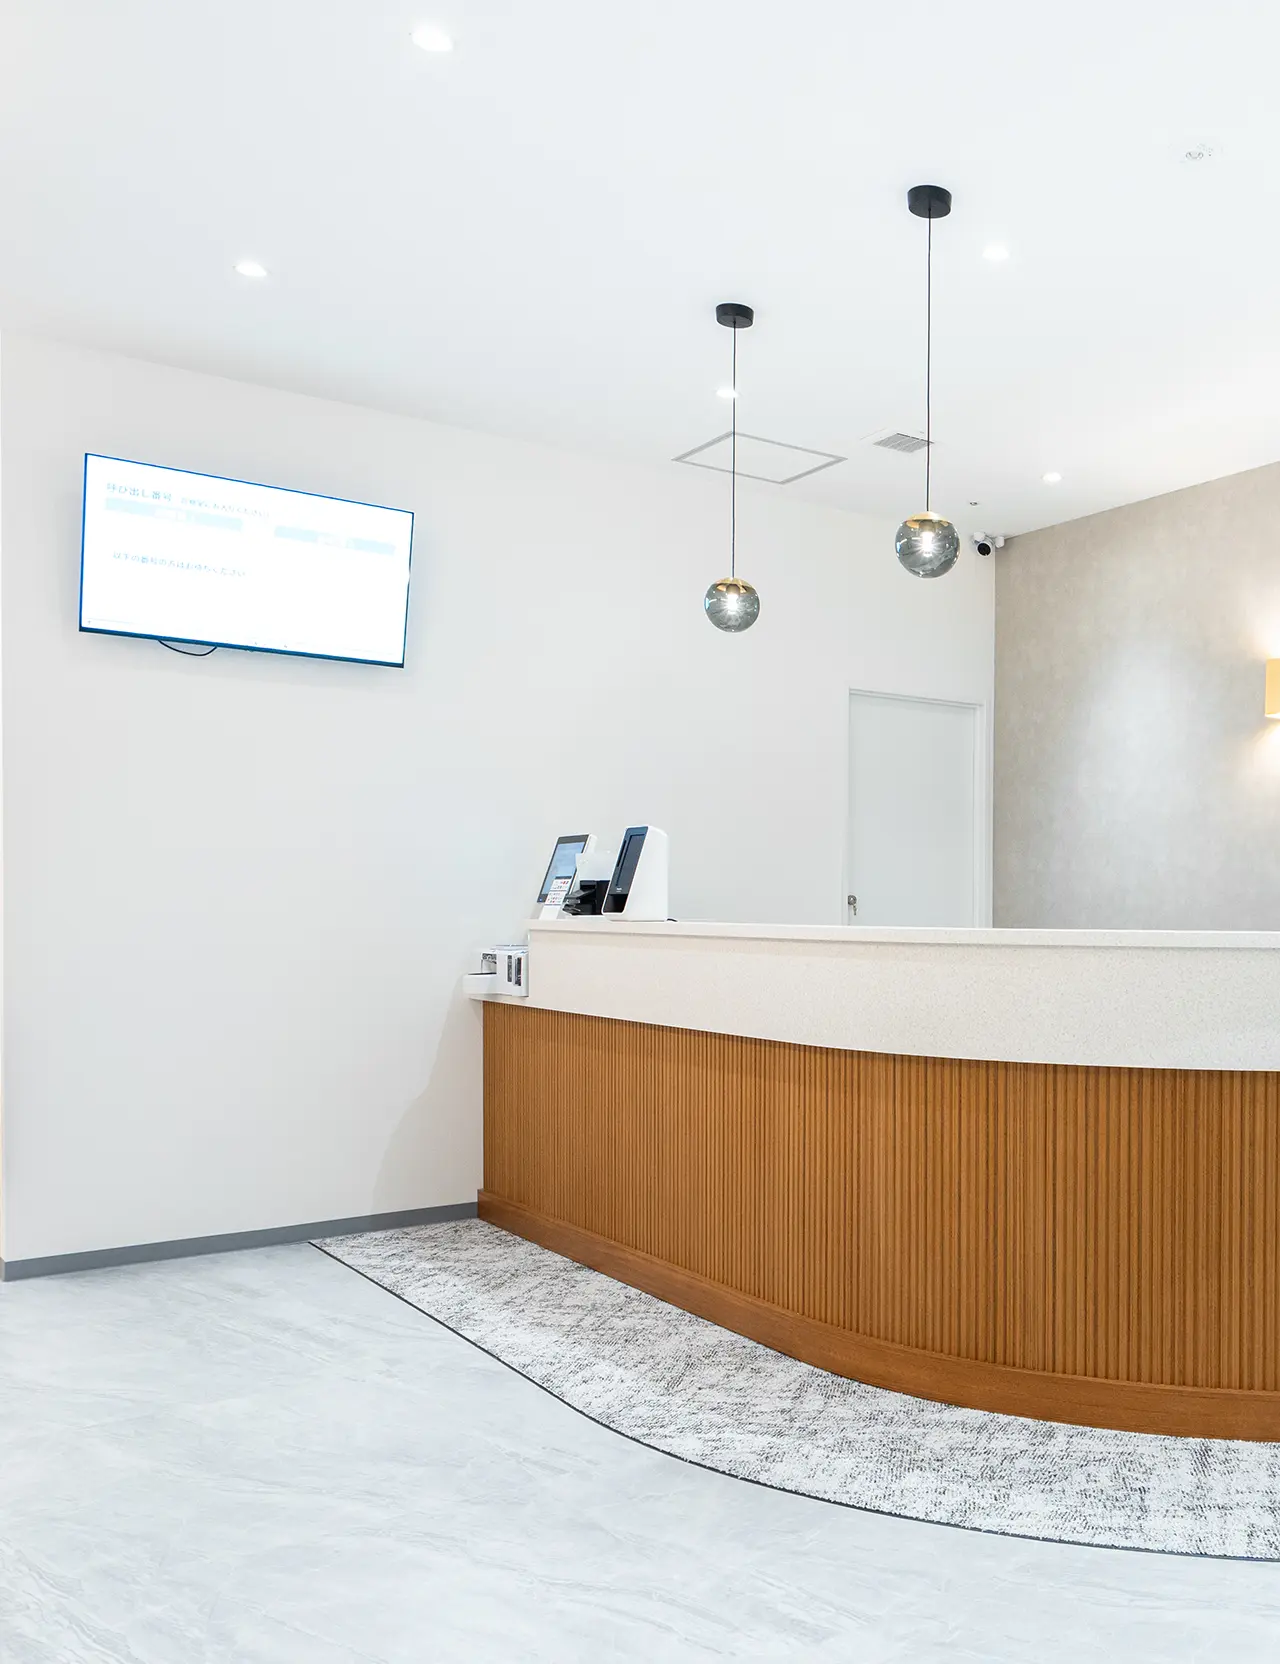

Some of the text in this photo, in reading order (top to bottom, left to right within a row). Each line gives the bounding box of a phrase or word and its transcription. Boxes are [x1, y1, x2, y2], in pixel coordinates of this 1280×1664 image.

[106, 482, 173, 502] 呼び出し番号
